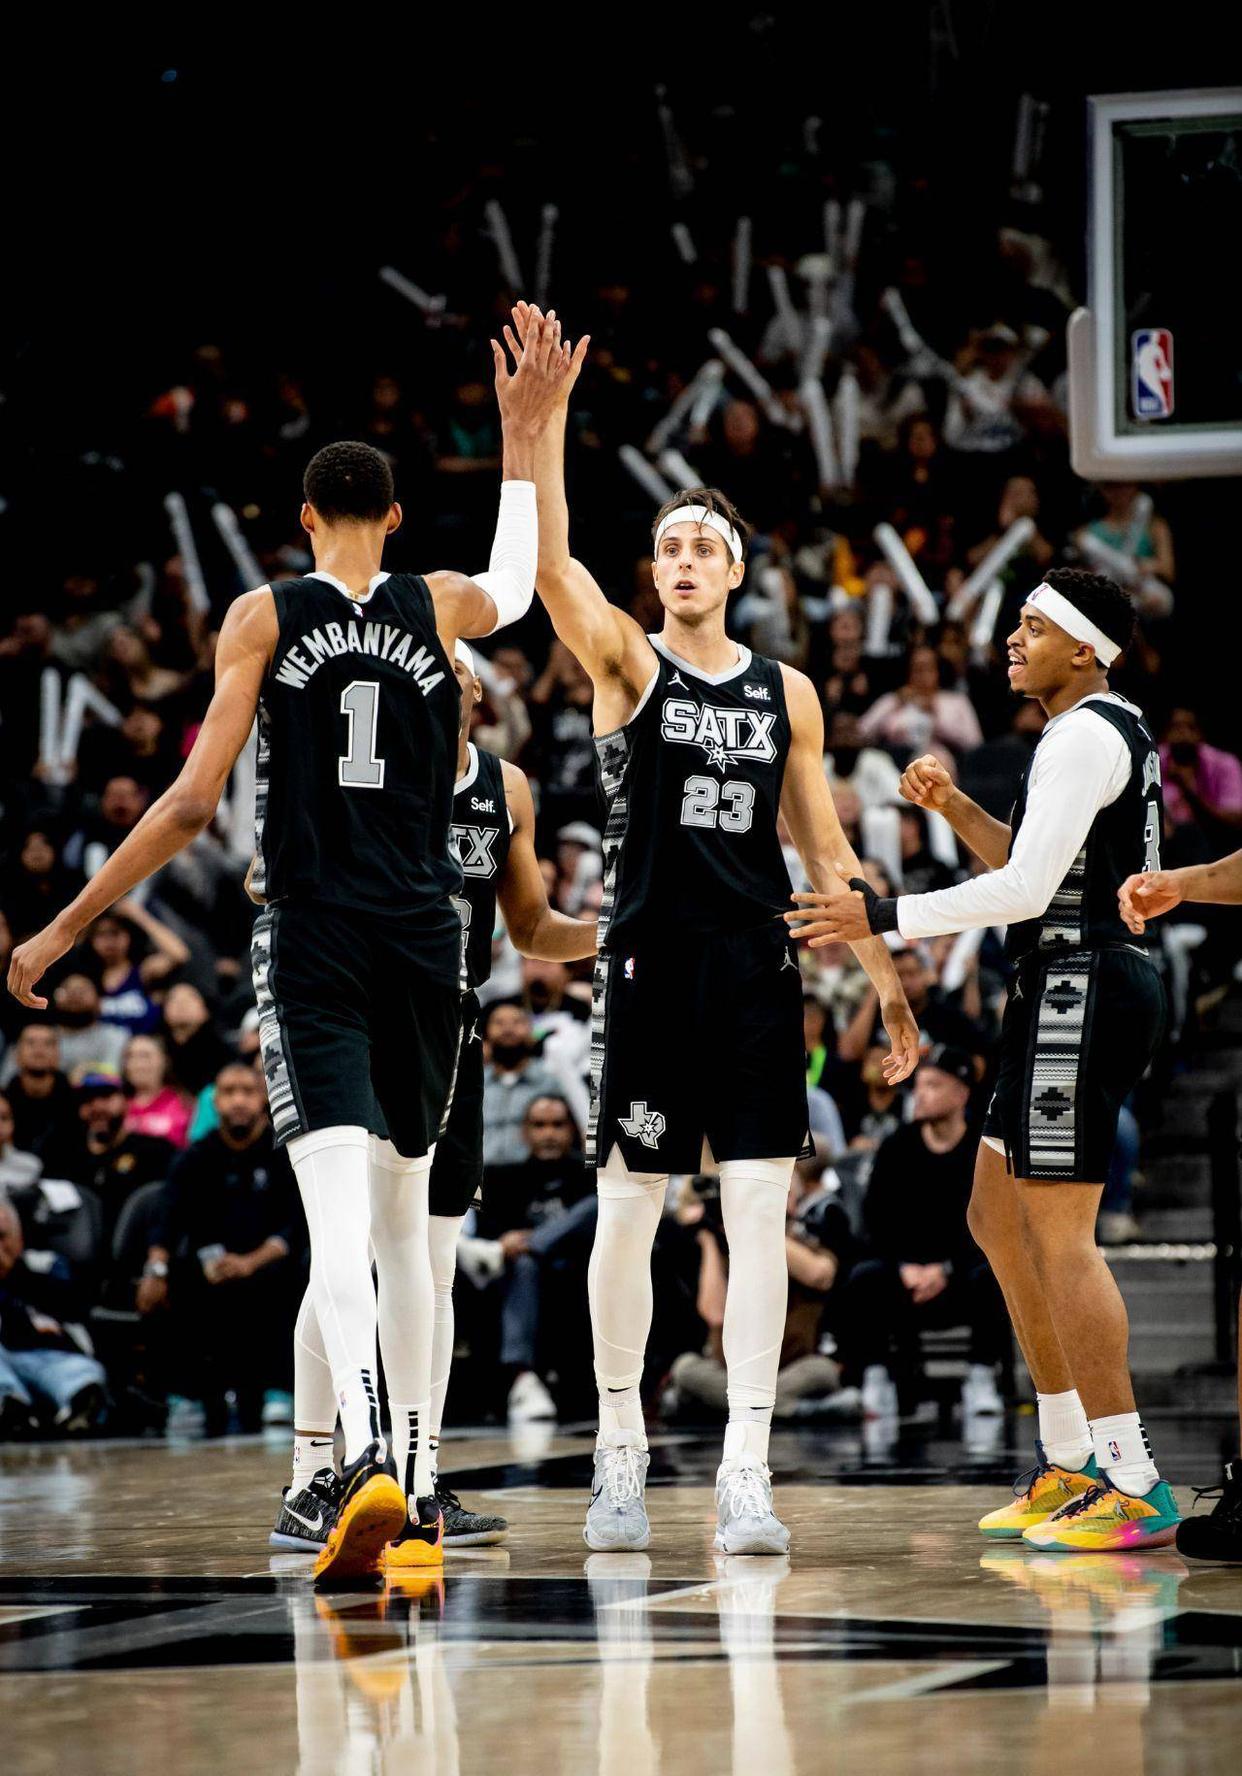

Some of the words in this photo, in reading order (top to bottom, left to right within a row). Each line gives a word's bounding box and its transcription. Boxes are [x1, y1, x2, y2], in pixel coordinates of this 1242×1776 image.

[275, 620, 446, 697] WEMBANYAMA
[338, 680, 386, 789] 1
[660, 697, 778, 765] SATX
[680, 774, 756, 834] 23
